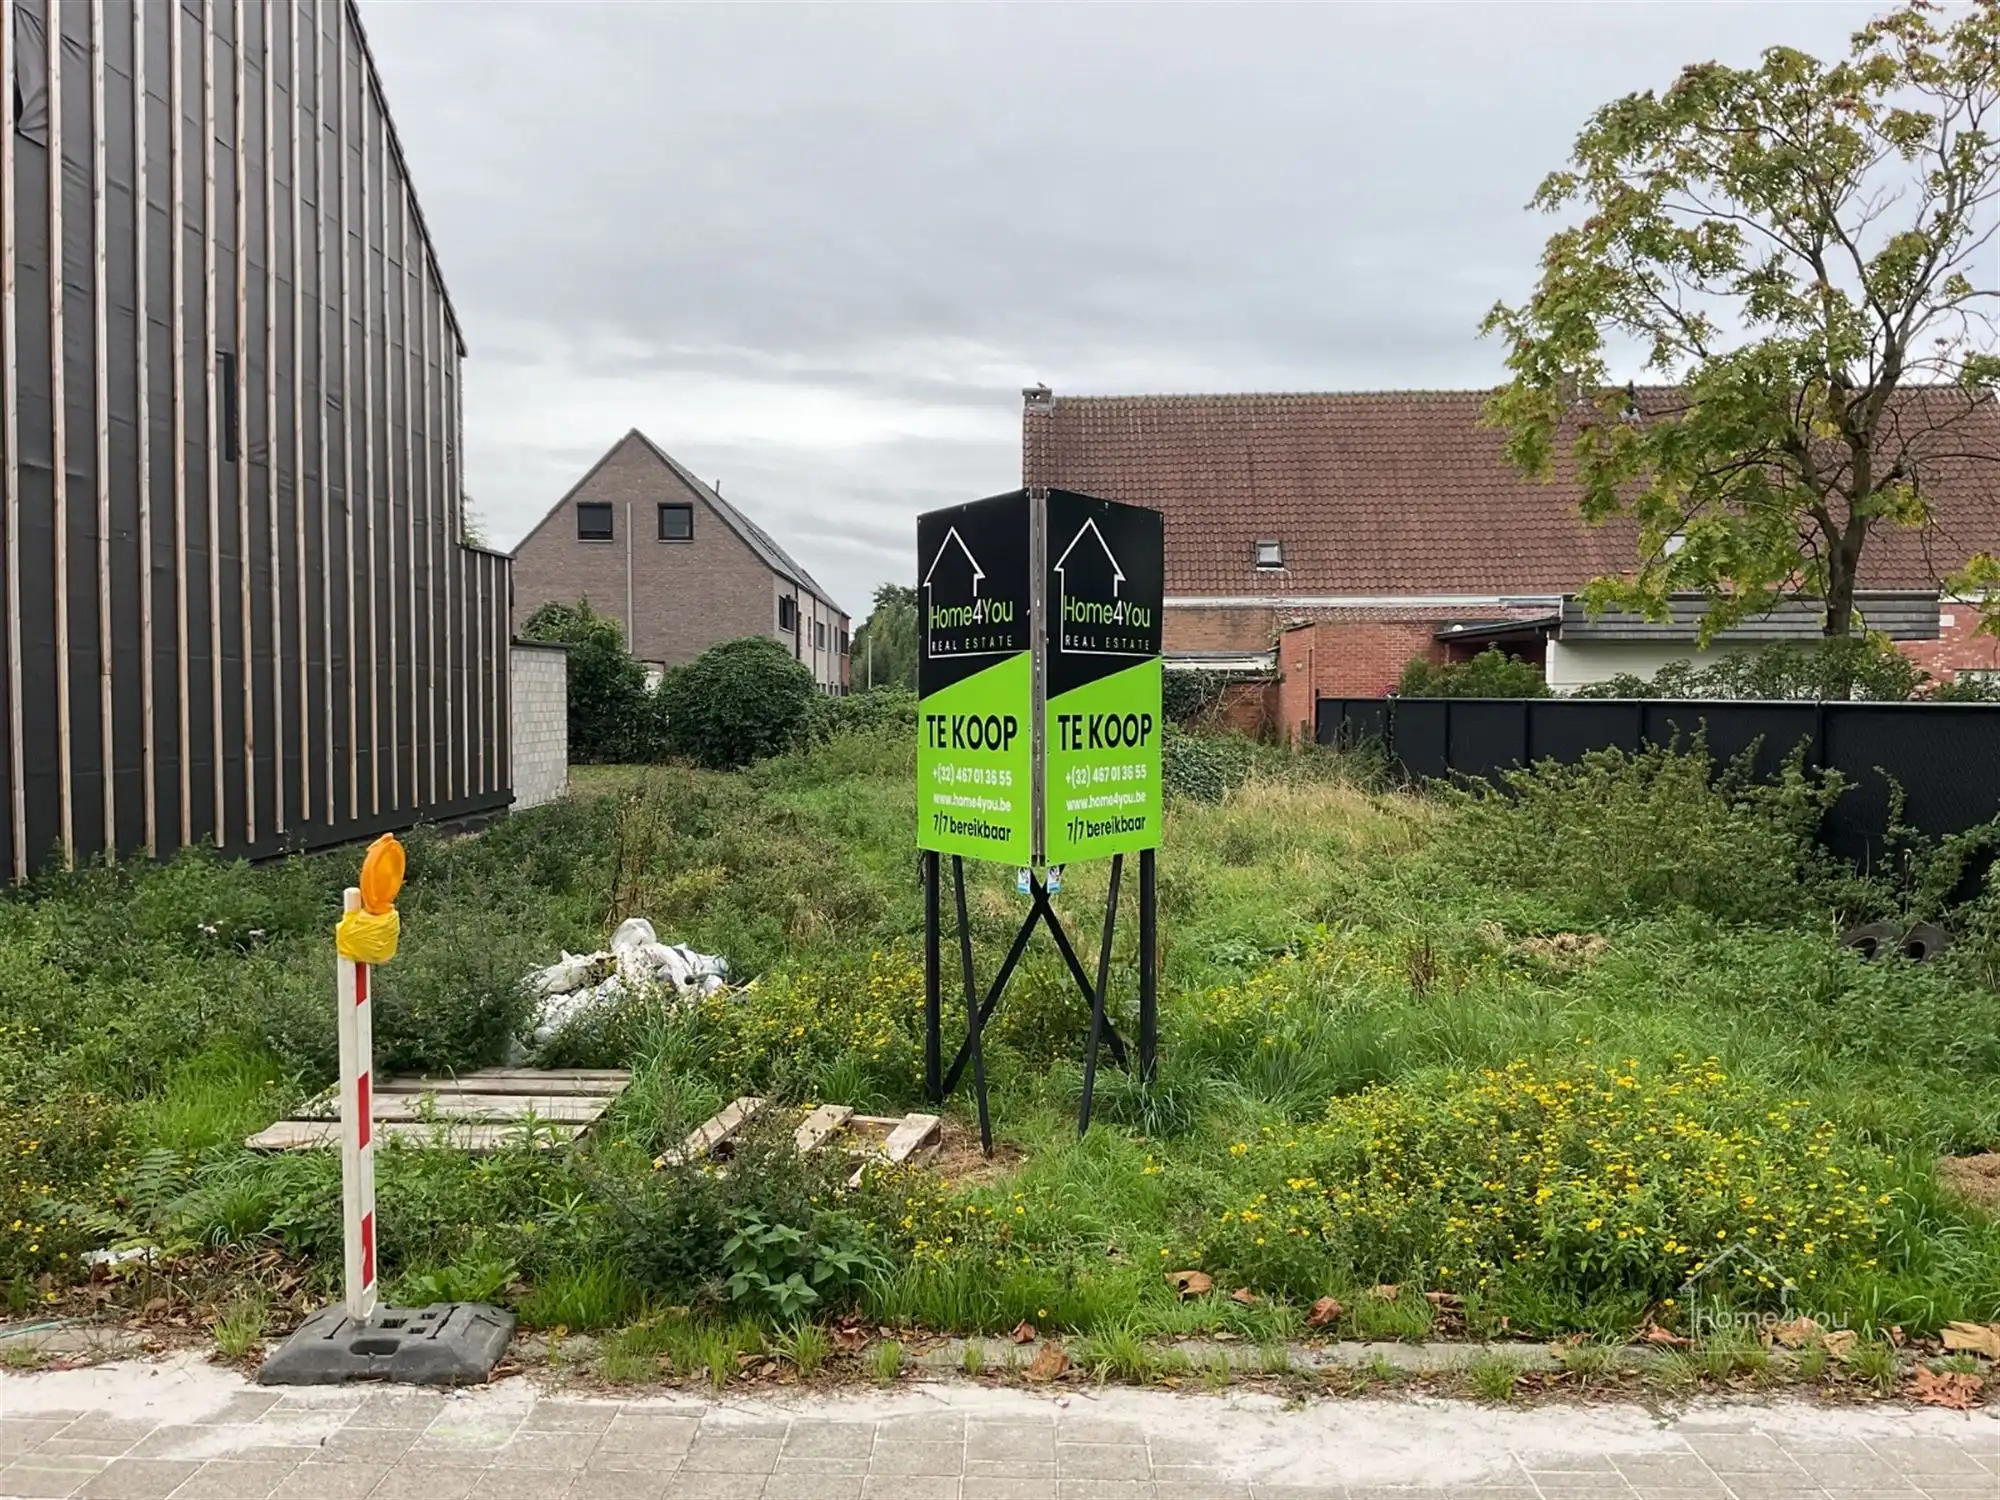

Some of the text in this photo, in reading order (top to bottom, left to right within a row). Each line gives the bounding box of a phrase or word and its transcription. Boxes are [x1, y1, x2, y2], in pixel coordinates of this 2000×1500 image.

[930, 598, 1013, 629] Home4You
[1064, 595, 1150, 628] Home4You
[931, 635, 1012, 652] REAL ESTATE
[1065, 634, 1150, 650] REAL ESTATE
[926, 715, 1017, 751] TE KOOP
[1058, 713, 1152, 750] TE KOOP
[932, 763, 1012, 787] +(32) 467 01 36 55
[1066, 764, 1147, 789] +(32) 467 01 36 55
[933, 793, 1012, 814] www.home4you.be
[1066, 791, 1146, 812] www.home4you.be
[933, 810, 1011, 841] 7/7 bereikbaar
[1067, 815, 1146, 844] 7/7 bereikbaar
